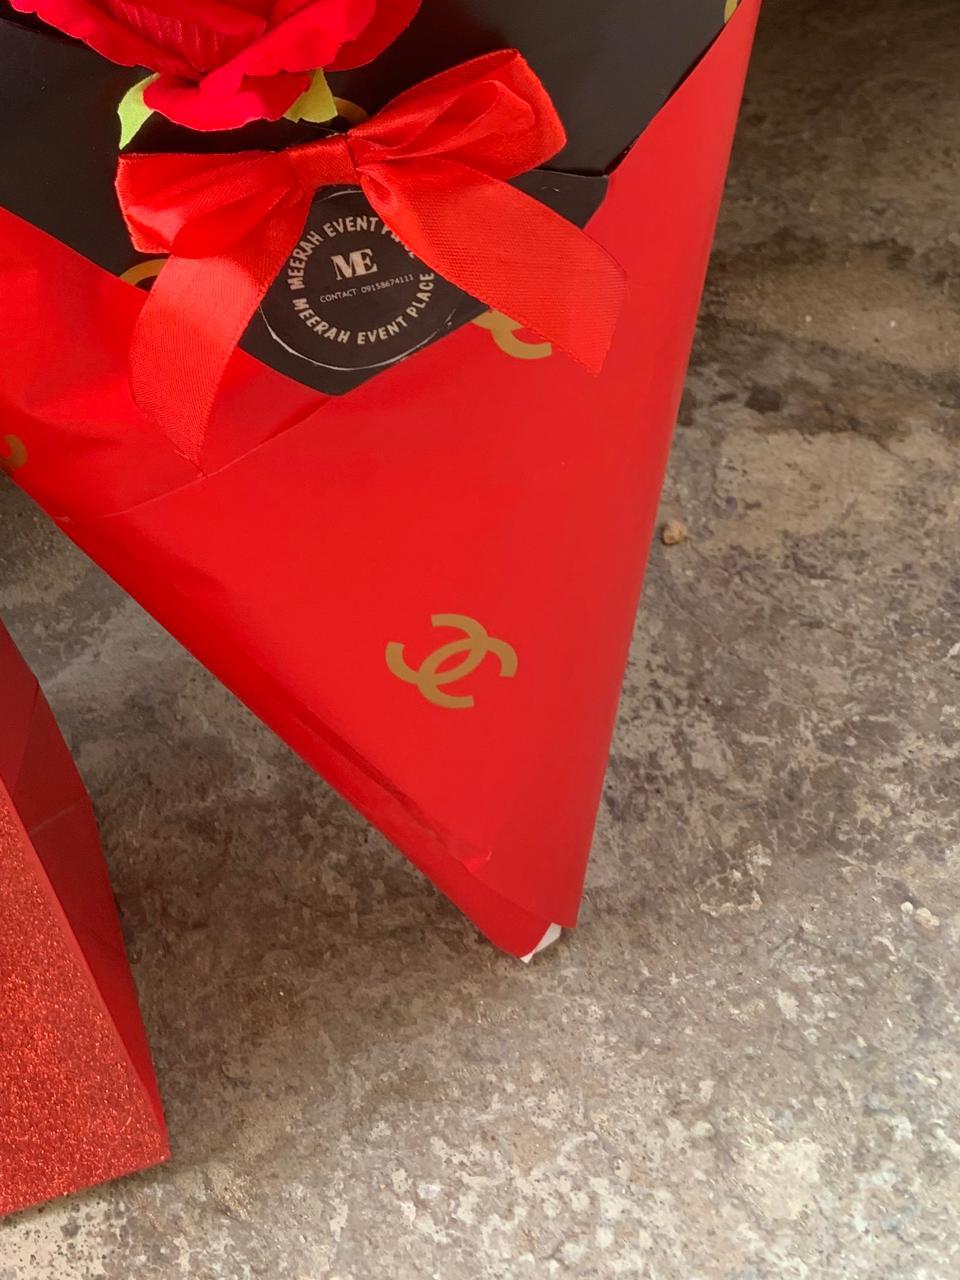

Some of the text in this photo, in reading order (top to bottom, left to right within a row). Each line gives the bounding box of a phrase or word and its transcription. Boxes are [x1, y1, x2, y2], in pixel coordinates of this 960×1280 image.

[287, 215, 379, 291] MEERAH EVENT
[330, 248, 379, 281] ME
[292, 272, 435, 345] MEERAH EVENT PLACE
[320, 288, 357, 303] CONTACT
